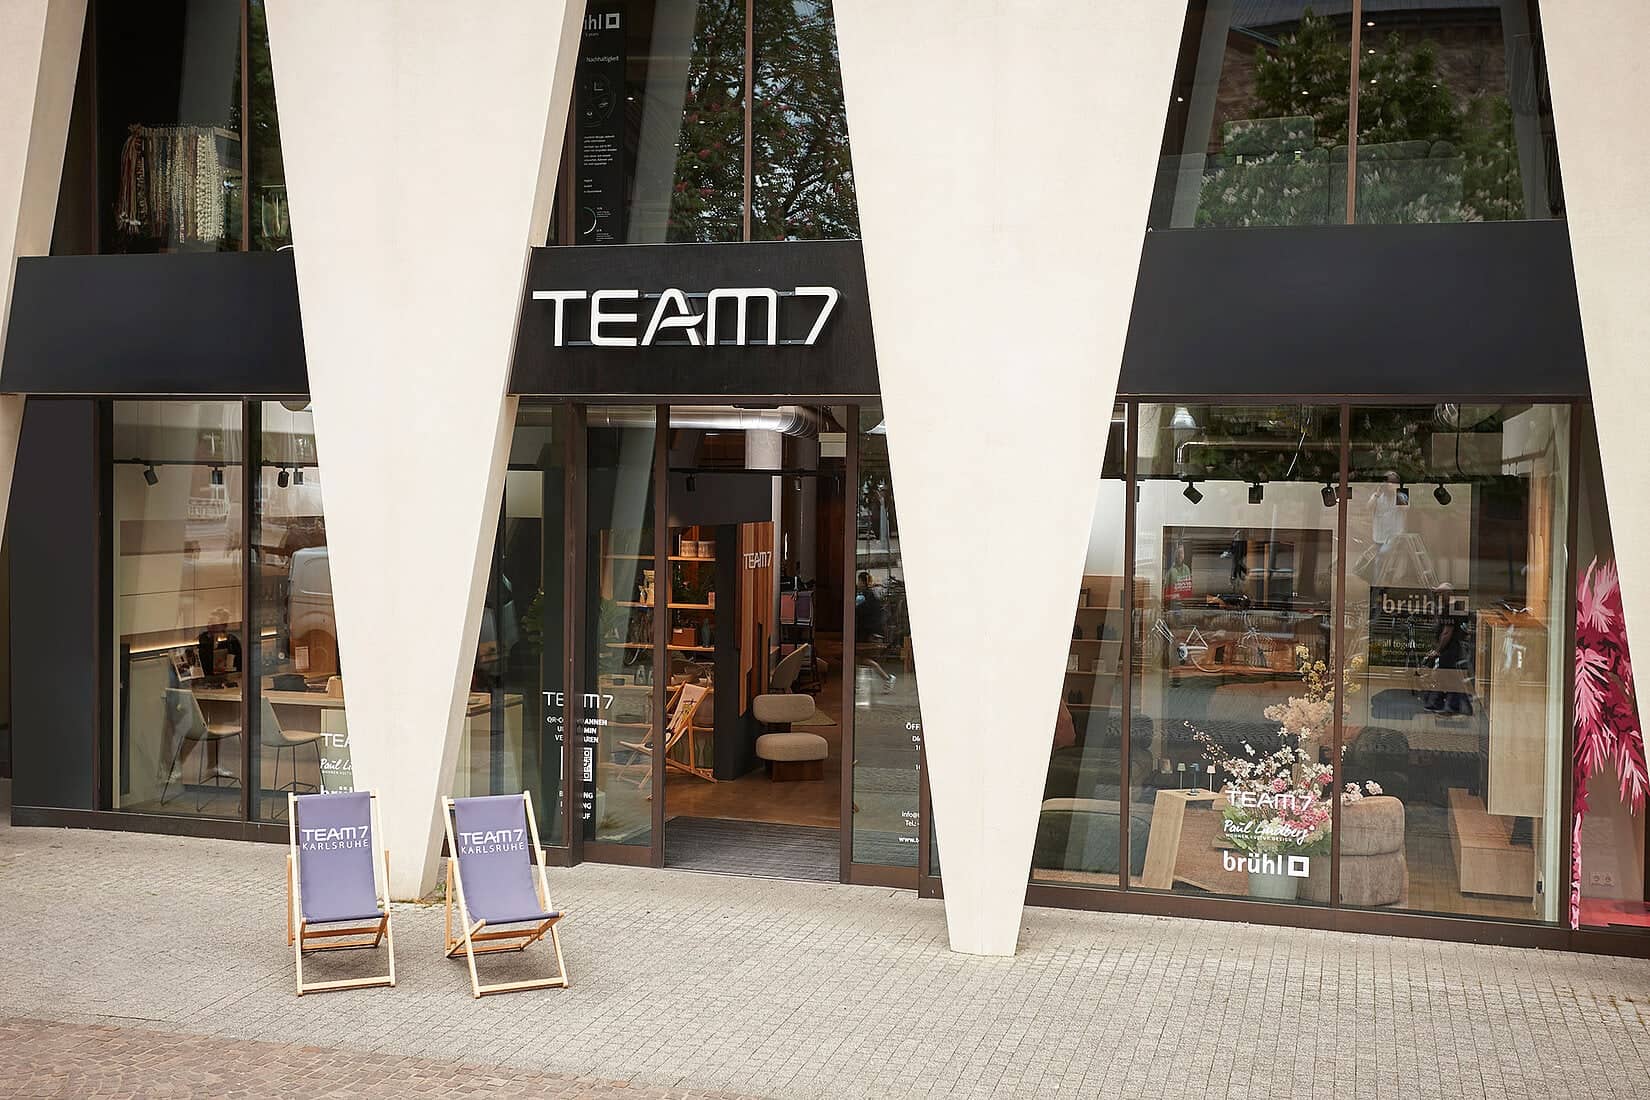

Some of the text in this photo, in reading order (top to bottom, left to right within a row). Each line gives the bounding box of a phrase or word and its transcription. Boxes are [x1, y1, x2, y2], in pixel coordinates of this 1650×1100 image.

[1382, 593, 1443, 616] brühl
[302, 839, 369, 851] KARLSRUHE
[461, 841, 525, 855] KARLSRUHE
[1223, 850, 1283, 875] brühl
